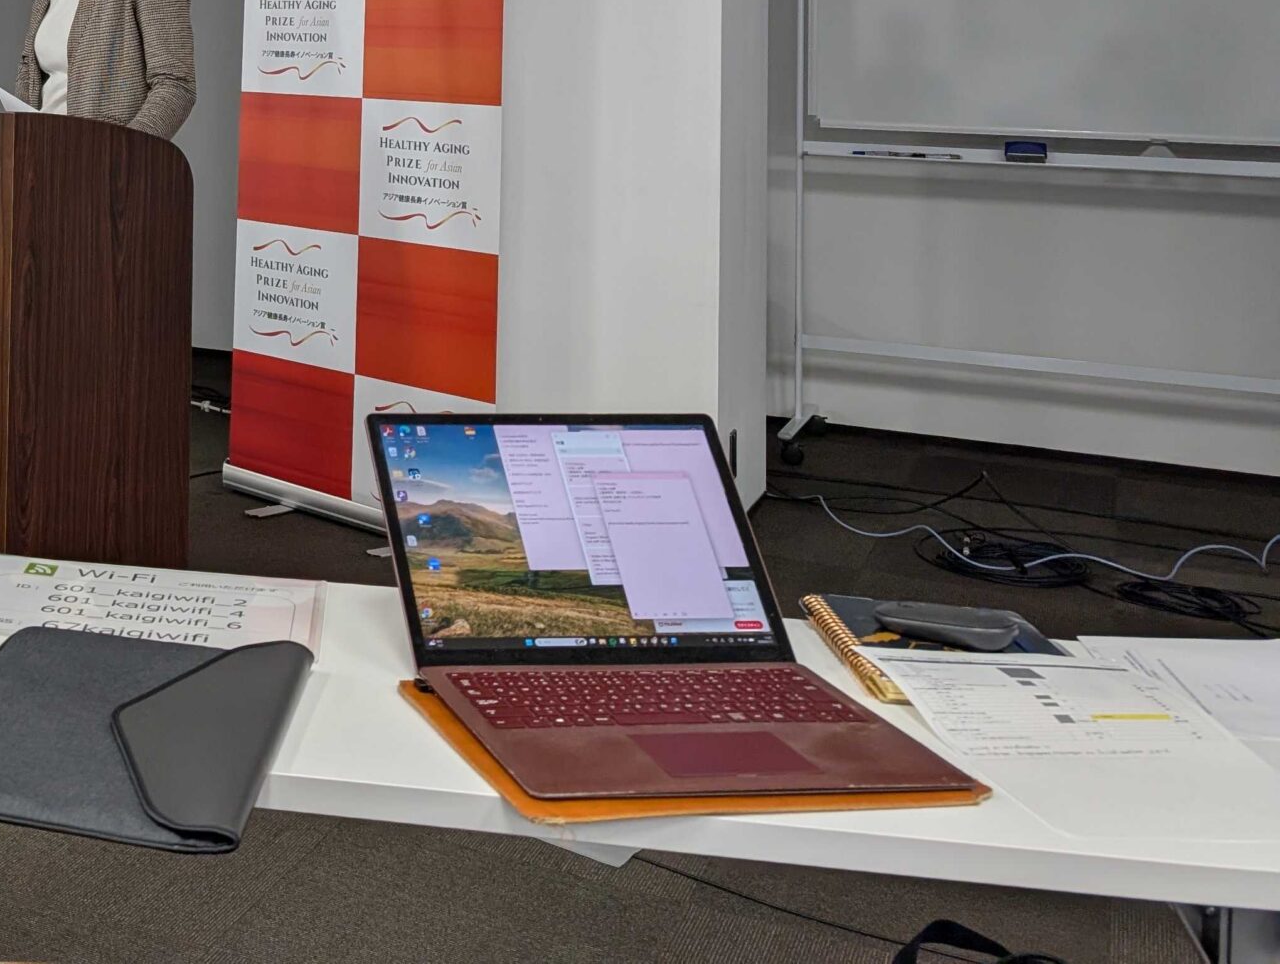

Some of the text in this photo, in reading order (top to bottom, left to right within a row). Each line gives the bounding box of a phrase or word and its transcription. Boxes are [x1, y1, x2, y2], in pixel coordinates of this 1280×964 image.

[259, 0, 337, 10] HEALTHY AGING
[265, 15, 330, 28] PRIZE for Asian
[266, 31, 327, 43] INNOVATION
[379, 137, 470, 155] HEALTHY AGING
[386, 155, 463, 173] PRIZE for Asian
[388, 172, 460, 190] INNOVATION
[250, 256, 329, 278] HEALTHY AGING
[256, 274, 322, 295] PRIZE for Asian
[257, 290, 319, 311] INNOVATION
[78, 568, 157, 584] Wi-Fi
[54, 583, 247, 607] 601_kaigiwifi_2
[47, 594, 245, 618] 601_kaigiwifi_4
[40, 605, 242, 630] 601_kaigiwifi_6
